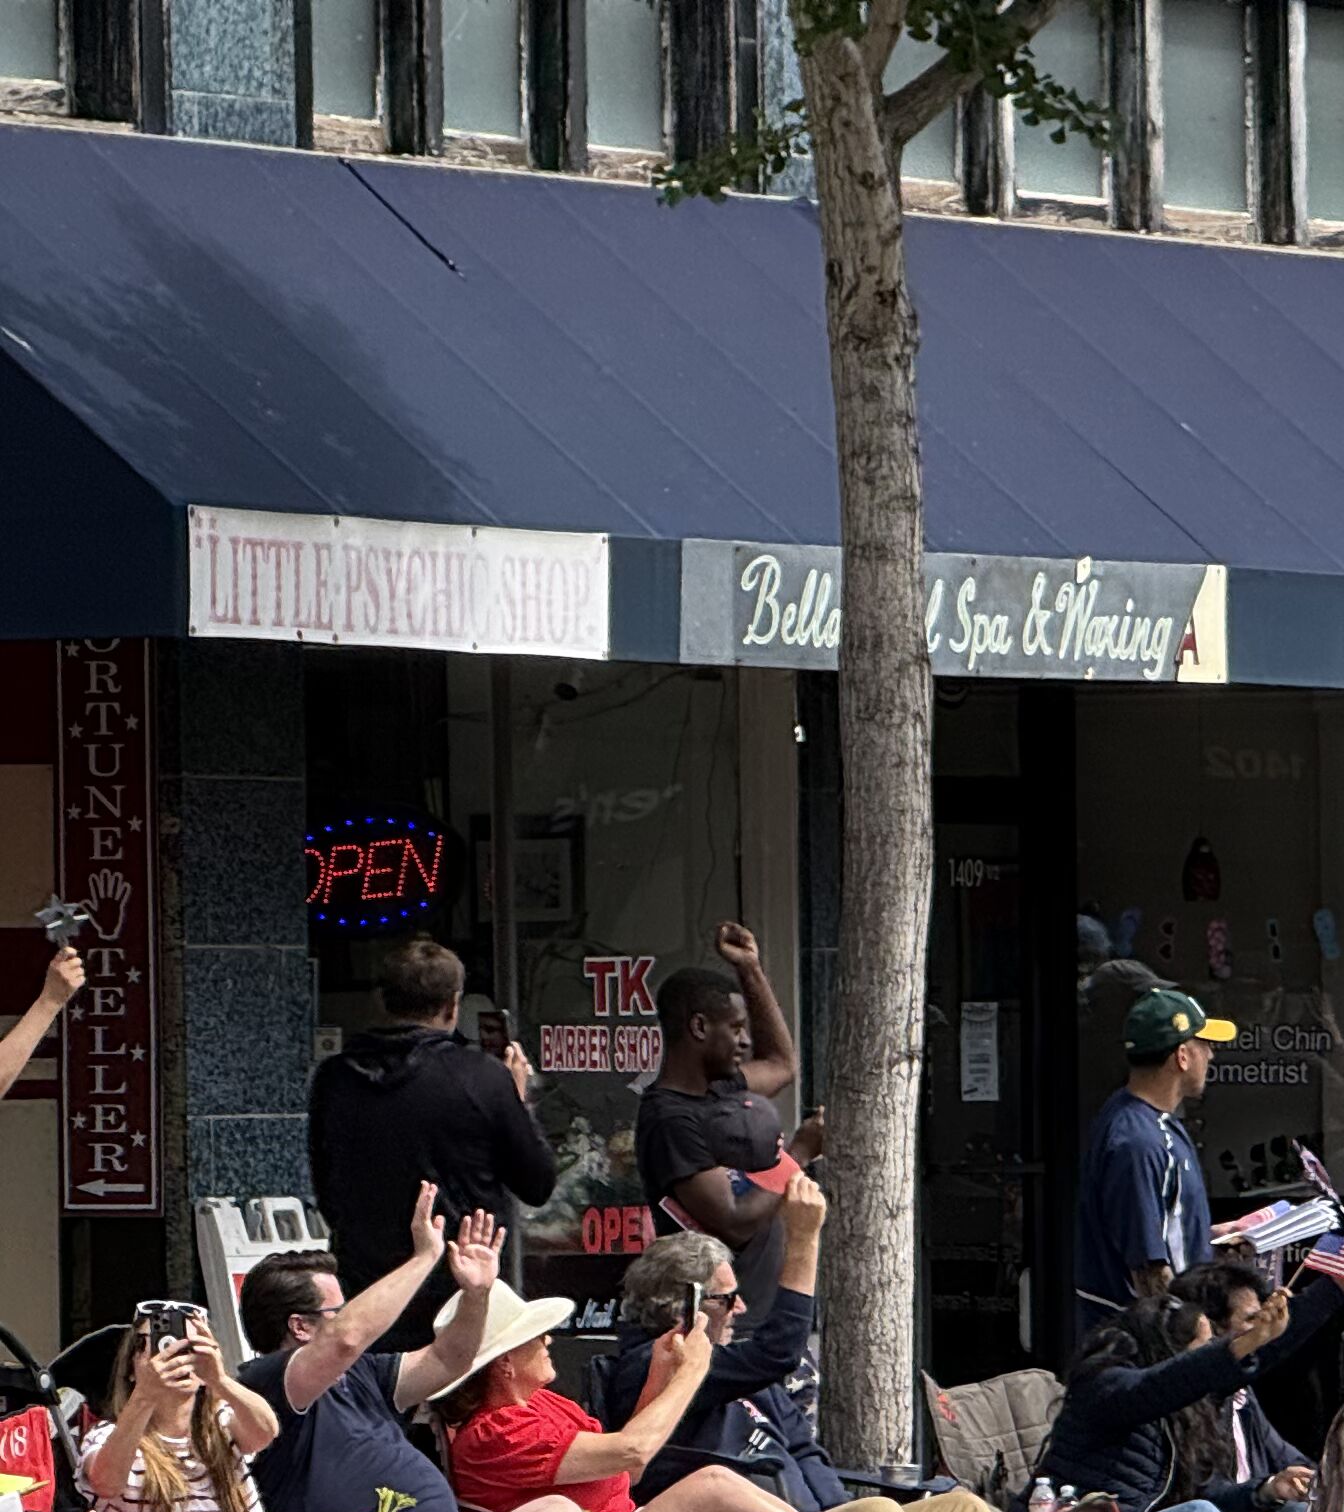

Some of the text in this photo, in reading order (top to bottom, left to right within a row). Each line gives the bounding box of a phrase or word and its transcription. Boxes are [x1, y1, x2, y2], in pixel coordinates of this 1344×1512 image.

[949, 577, 1013, 670] Spa
[1022, 571, 1053, 656] &
[1055, 579, 1173, 680] Waxing
[84, 638, 124, 861] RTUNE
[948, 858, 984, 888] 1409
[584, 955, 658, 1017] TK
[86, 947, 128, 1173] TELLER
[540, 1024, 663, 1072] BARBER SHOP
[1273, 1025, 1332, 1050] Chin
[1204, 1059, 1309, 1084] ometrist
